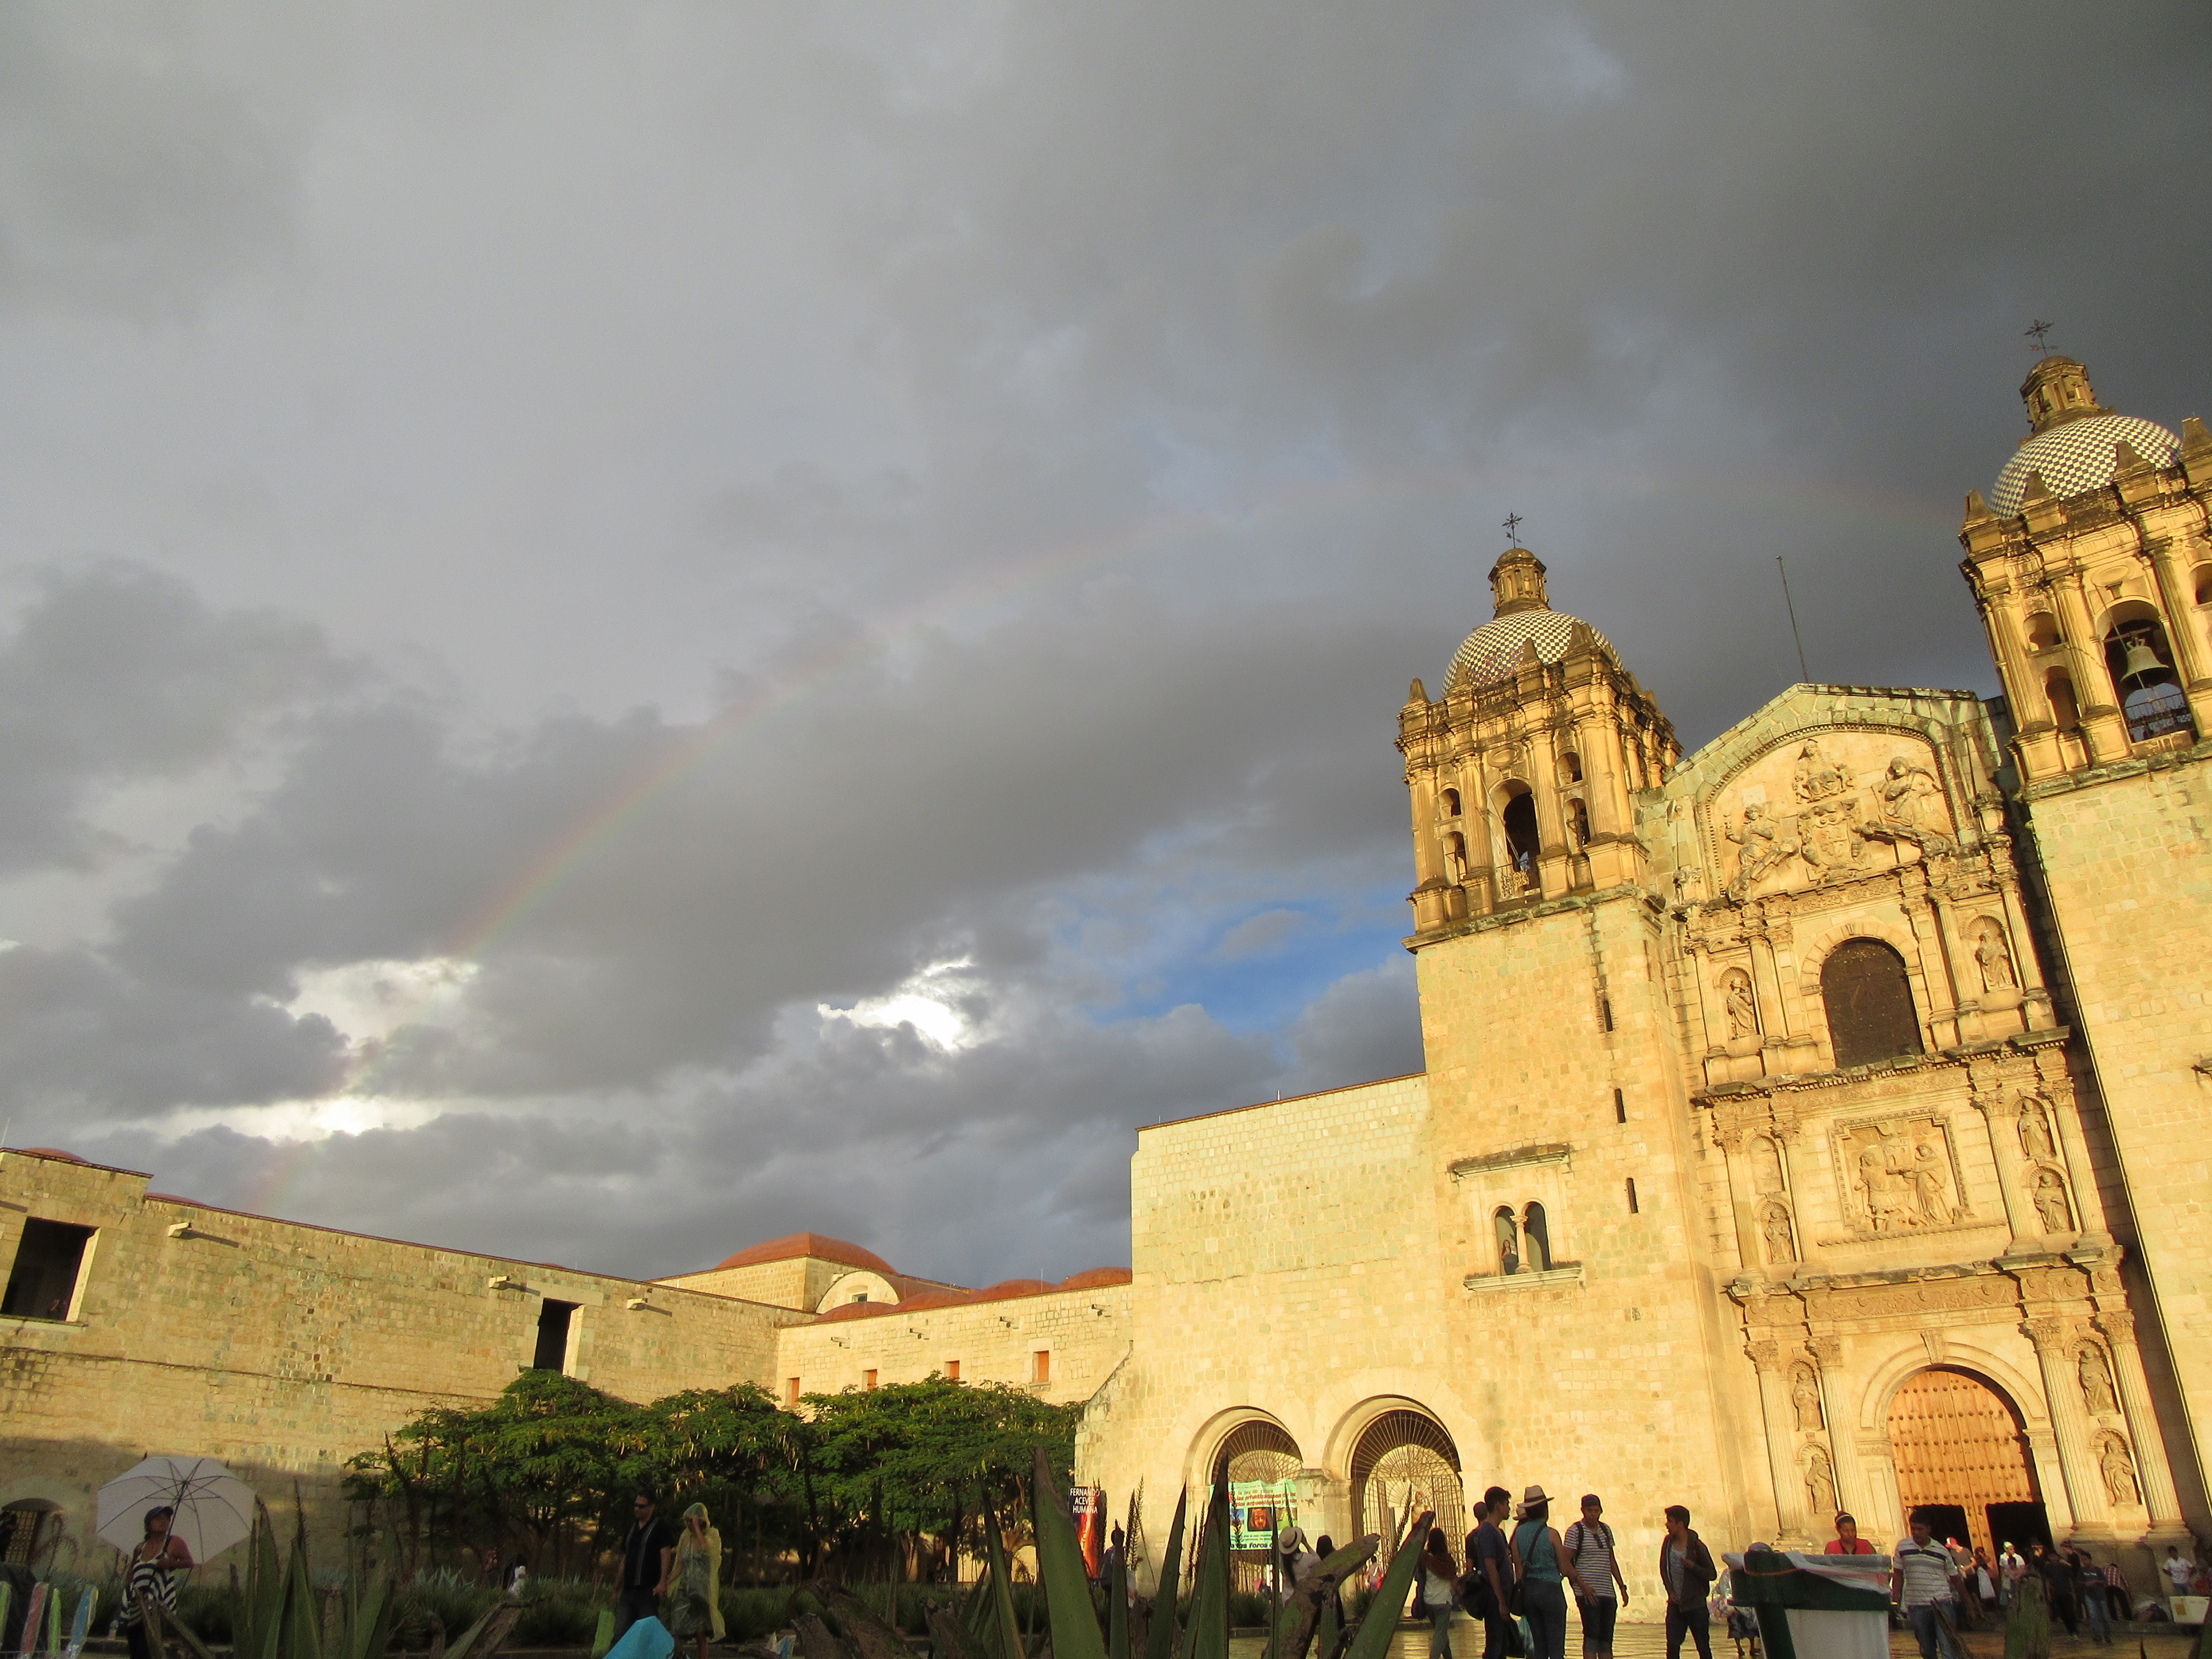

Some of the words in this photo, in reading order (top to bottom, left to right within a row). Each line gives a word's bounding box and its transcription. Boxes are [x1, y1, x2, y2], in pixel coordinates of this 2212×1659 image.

[1070, 1488, 1100, 1497] FERNANDO
[1074, 1497, 1095, 1505] ACEVES
[1073, 1505, 1098, 1514] HUMANA
